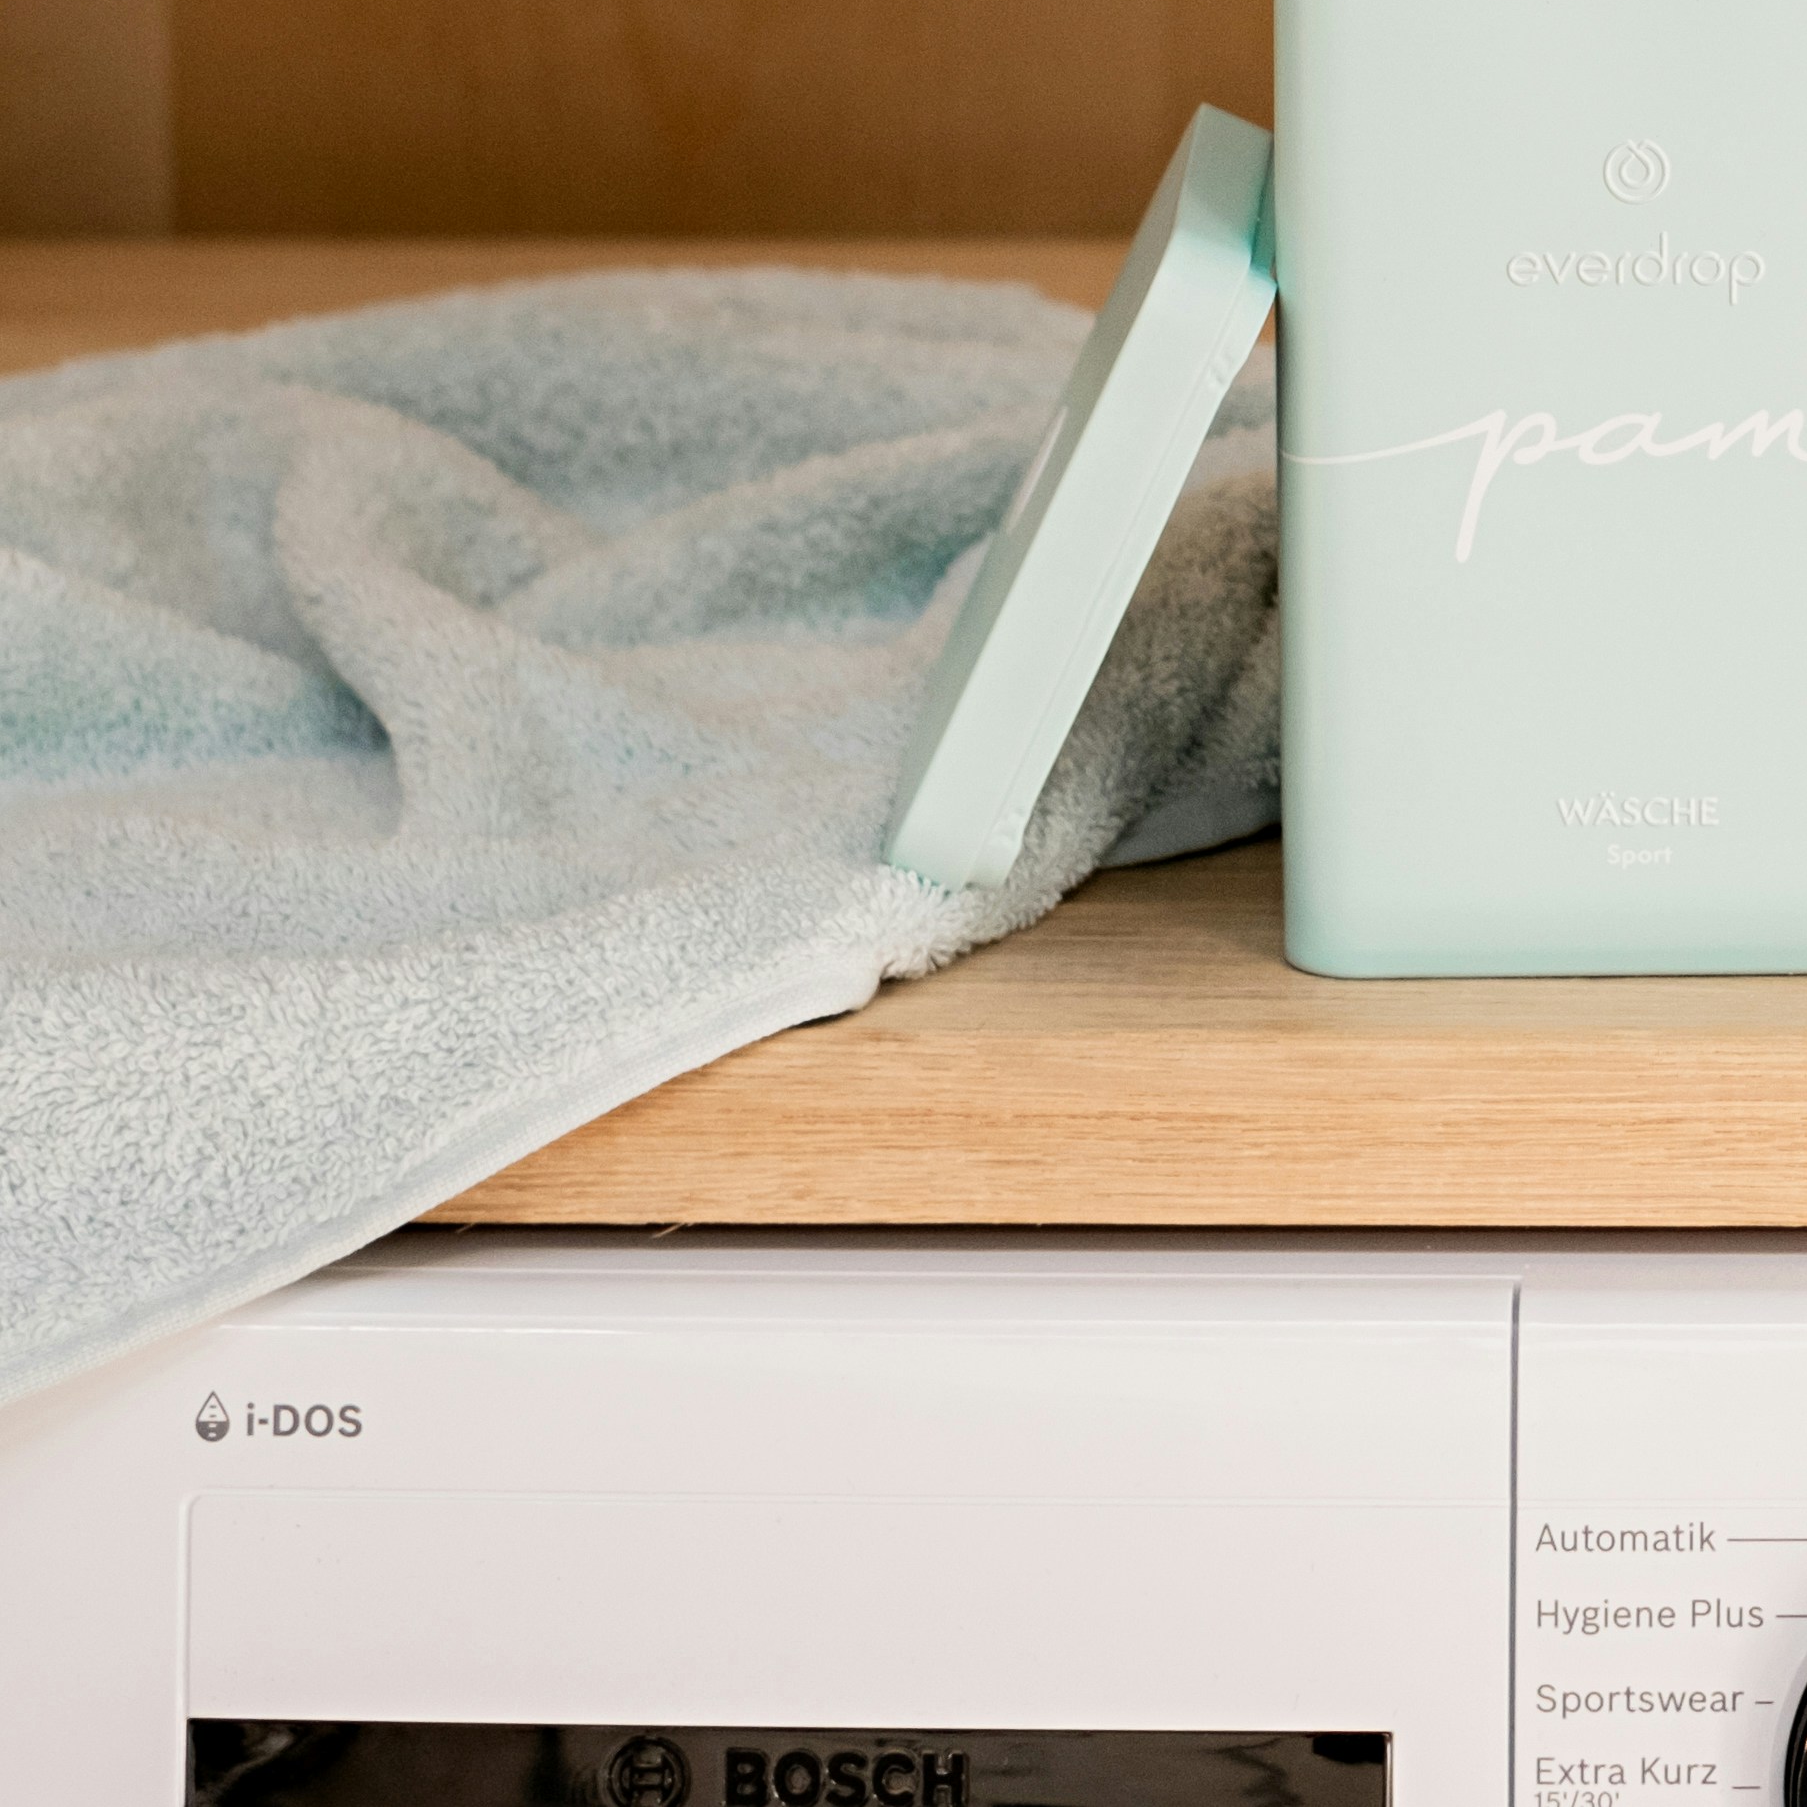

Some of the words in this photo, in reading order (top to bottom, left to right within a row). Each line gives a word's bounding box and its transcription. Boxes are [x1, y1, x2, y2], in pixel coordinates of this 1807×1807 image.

[1505, 231, 1767, 307] everdrop
[1556, 790, 1721, 828] WÄSCHE
[1606, 844, 1673, 870] Sport
[246, 1402, 363, 1438] i-DOS
[1535, 1521, 1717, 1553] Automatik
[1536, 1599, 1677, 1635] Hygiene
[1691, 1597, 1765, 1629] Plus
[1535, 1683, 1745, 1719] Sportswear
[724, 1746, 970, 1807] BOSCH
[1535, 1757, 1627, 1786] Extra
[1641, 1756, 1718, 1786] Kurz
